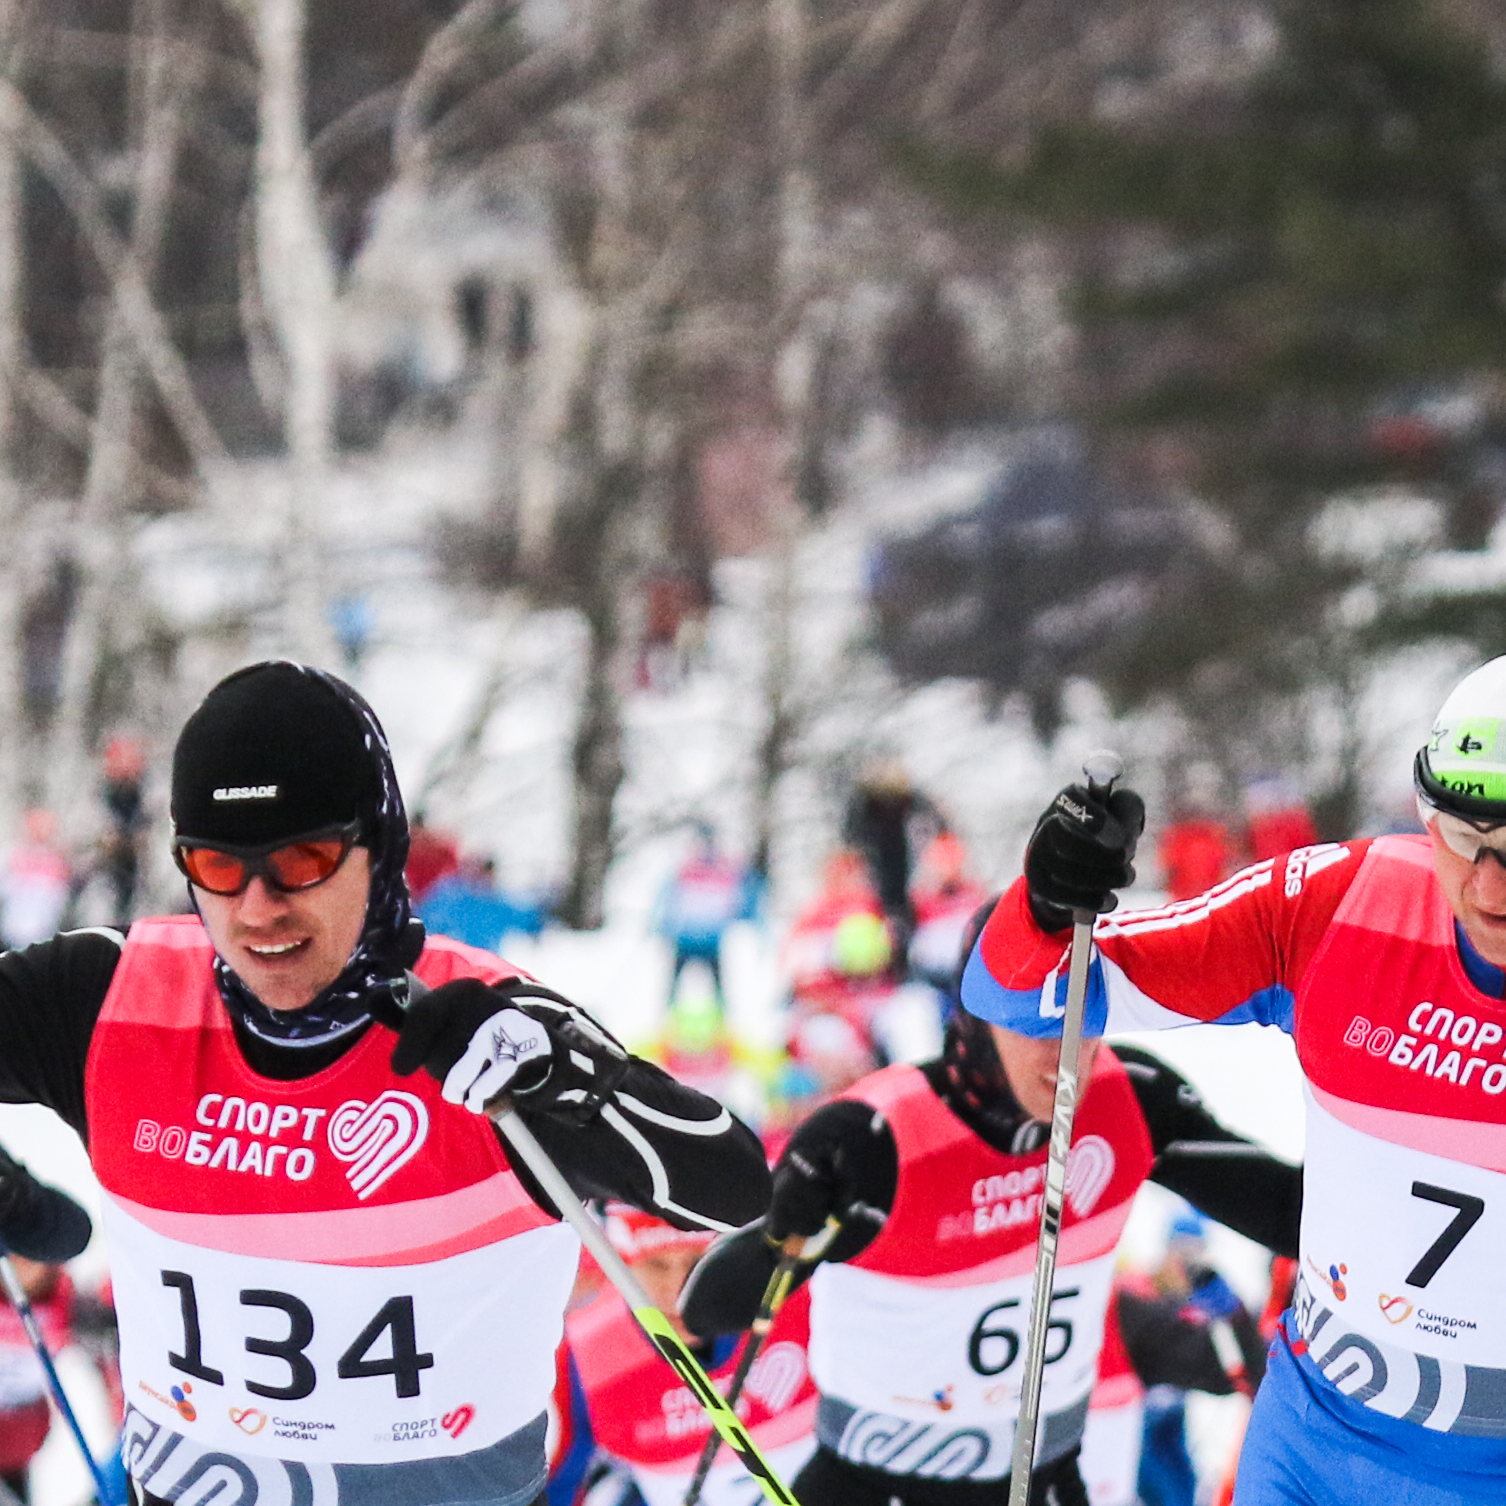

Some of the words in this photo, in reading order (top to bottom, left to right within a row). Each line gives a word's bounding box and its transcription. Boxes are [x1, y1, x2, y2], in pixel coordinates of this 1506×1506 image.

[213, 785, 277, 800] GLISSADE
[195, 1093, 327, 1141] СПОРТ
[971, 1163, 1047, 1207] СПОР
[1404, 1180, 1485, 1289] 7
[1417, 1308, 1478, 1330] Синдром
[160, 1268, 435, 1401] 134
[967, 1285, 1080, 1377] 65
[1414, 1322, 1458, 1339] любви
[272, 1415, 336, 1432] Синдром
[273, 1427, 319, 1442] любви
[391, 1417, 438, 1433] СПОРТ
